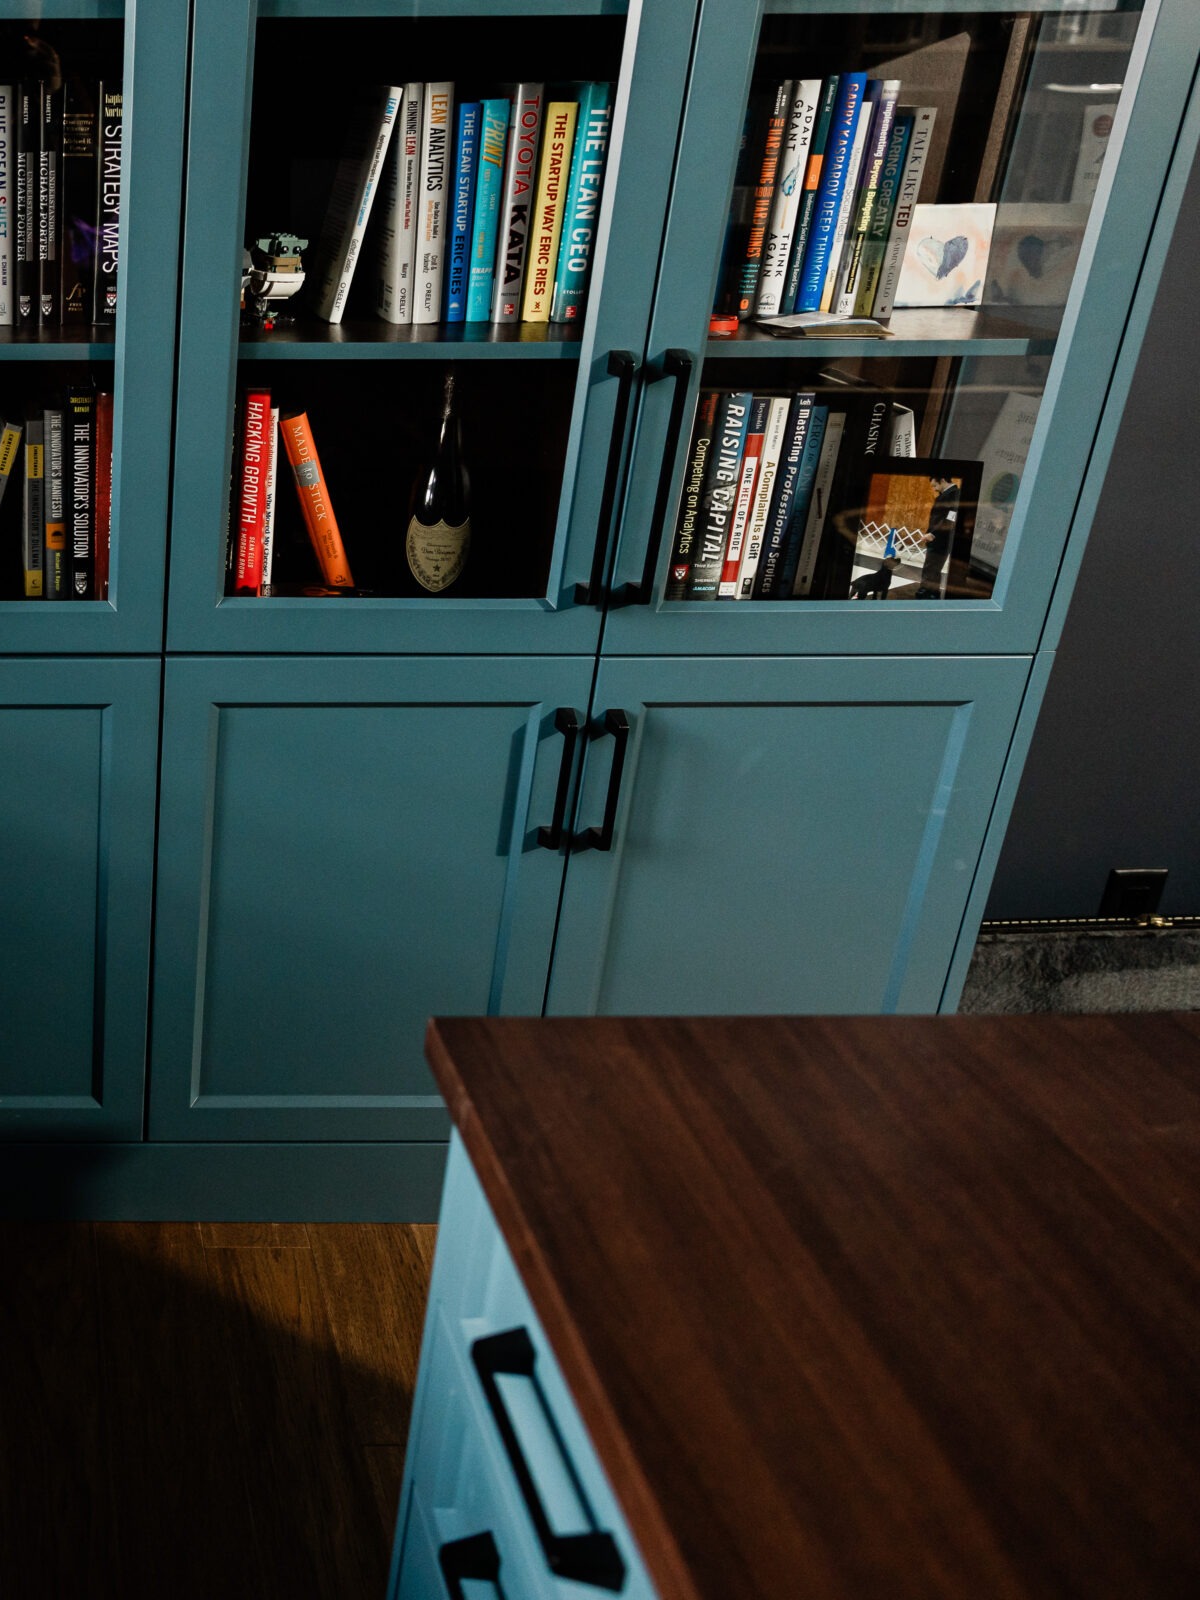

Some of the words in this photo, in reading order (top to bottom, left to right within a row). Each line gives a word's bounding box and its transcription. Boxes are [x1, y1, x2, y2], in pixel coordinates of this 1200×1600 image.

[406, 100, 418, 134] RUNNING
[431, 93, 448, 124] LEAN
[463, 112, 475, 136] THE
[555, 113, 568, 139] THE
[787, 100, 802, 151] GRANT
[800, 106, 813, 146] ADAM
[841, 83, 859, 126] GARRY
[405, 136, 416, 155] LEAN
[514, 96, 540, 195] TOYOTA
[585, 106, 611, 152] THE
[874, 101, 894, 158] Implementing
[885, 125, 905, 176] DARING
[909, 128, 928, 165] TALK
[103, 124, 122, 215] STRATEGY
[427, 128, 447, 191] ANALYTICS
[461, 140, 472, 173] LEAN
[548, 143, 565, 201] STARTUP
[759, 156, 776, 185] THING
[827, 129, 848, 196] KASPAROV
[869, 160, 883, 188] Beyond
[17, 152, 26, 212] MICHAEL
[40, 151, 49, 212] MICHAEL
[574, 160, 606, 220] LEAN
[902, 169, 918, 201] LIKE
[455, 176, 469, 232] STARTUP
[542, 204, 555, 233] WAY
[819, 201, 835, 233] DEEP
[858, 192, 876, 231] Budgeting
[874, 179, 894, 237] GREATLY
[896, 203, 911, 228] TED
[18, 214, 26, 261] PORTER
[40, 213, 48, 260] PORTER
[102, 224, 119, 274] MAPS
[454, 235, 465, 262] ERIC
[504, 204, 528, 285] KATA
[538, 236, 552, 264] ERIC
[567, 227, 592, 272] CEO
[746, 229, 763, 258] THINGS
[762, 232, 778, 278] AGAIN
[775, 234, 789, 278] THINK
[451, 264, 462, 295] RIES
[534, 267, 547, 296] RIES
[806, 235, 827, 292] THINKING
[51, 414, 61, 428] THE
[74, 422, 89, 443] THE
[754, 401, 765, 430] Reynolds
[787, 409, 811, 463] Mastering
[51, 429, 61, 476] INNOVATOR'S
[715, 403, 746, 483] RAISING
[765, 460, 775, 469] A
[72, 444, 89, 509] INNOVATOR'S
[293, 426, 310, 464] MADE
[302, 467, 314, 480] to
[310, 483, 326, 521] STICK
[688, 438, 710, 493] Competing
[743, 467, 753, 485] ONE
[51, 478, 61, 518] MANIFESTO
[241, 465, 260, 524] GROWTH
[684, 493, 698, 509] on
[739, 487, 750, 508] HELL
[755, 471, 773, 522] Complaint
[772, 466, 797, 548] Professional
[678, 509, 697, 554] Analytics
[701, 488, 732, 563] CAPITAL
[737, 511, 745, 523] OF
[247, 536, 255, 551] SEAN
[731, 532, 742, 551] RIDE
[748, 542, 760, 560] Gift
[761, 551, 779, 593] Services
